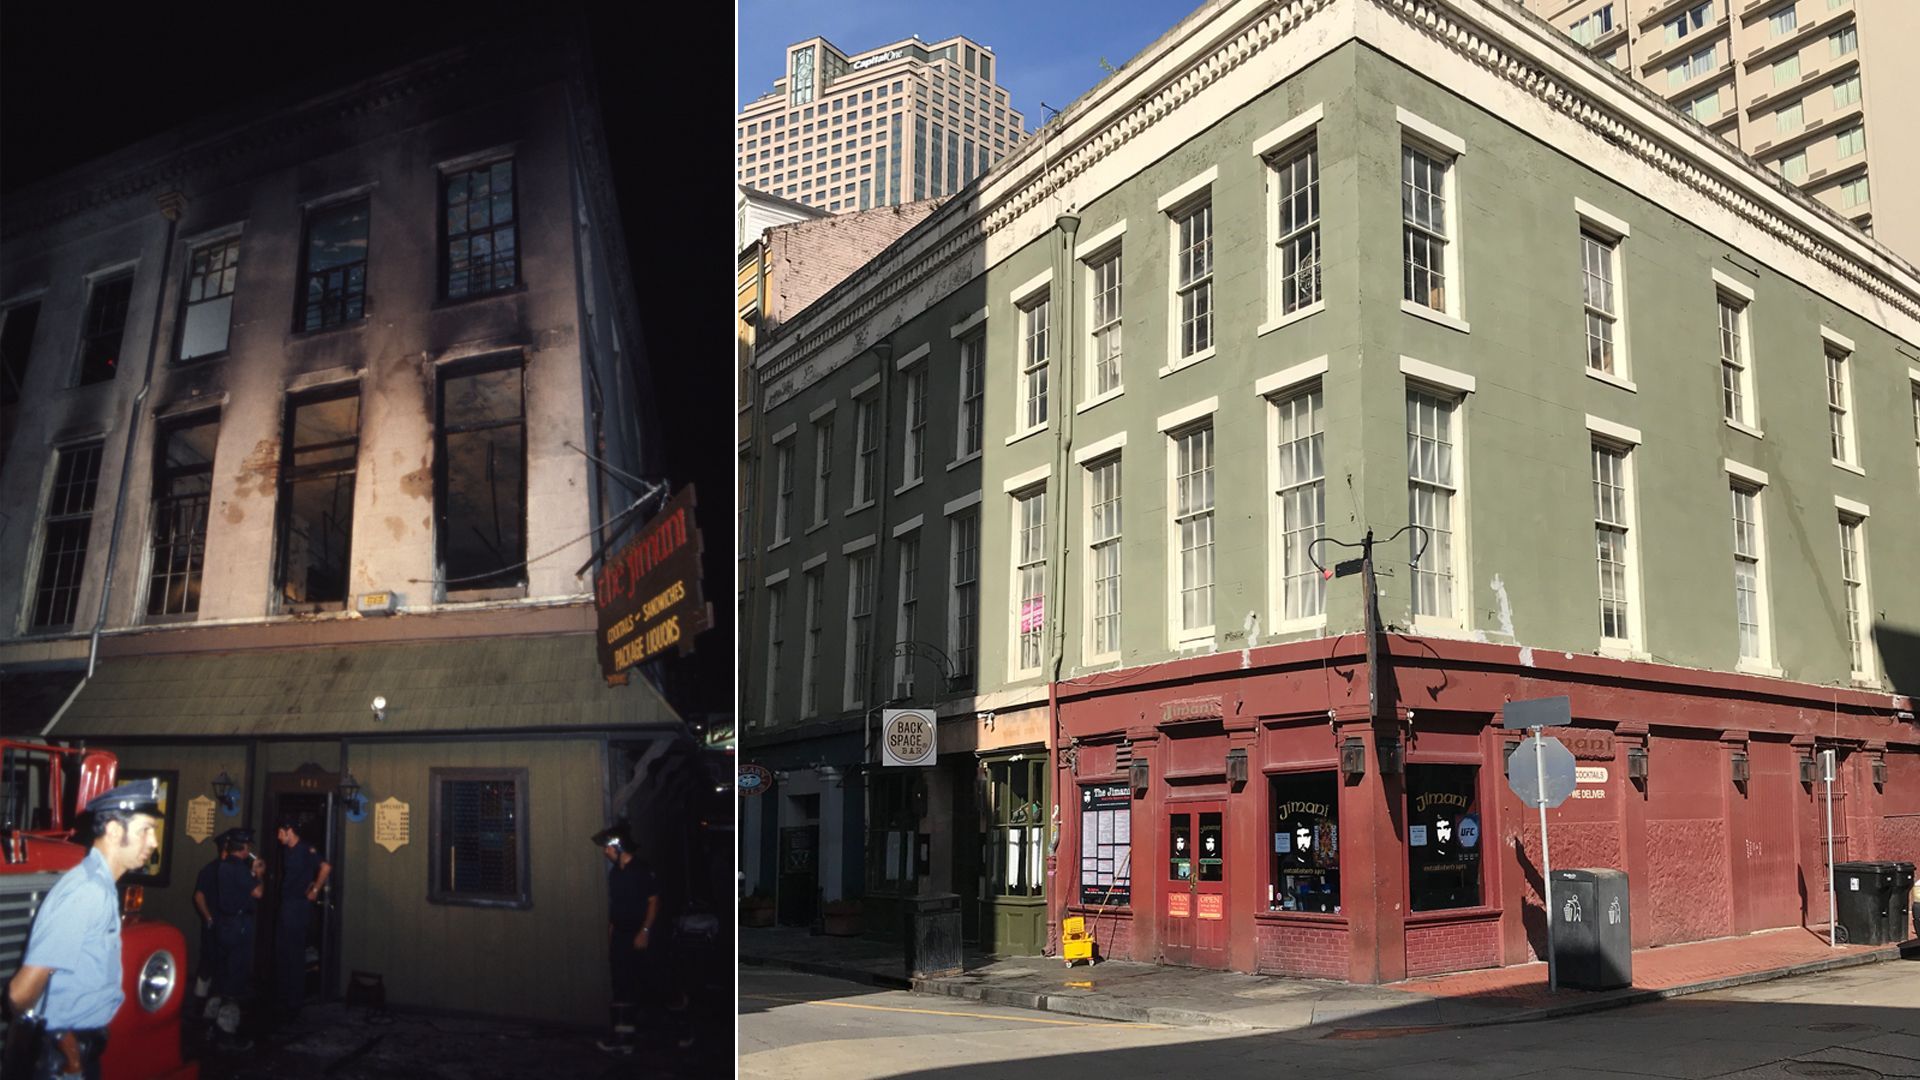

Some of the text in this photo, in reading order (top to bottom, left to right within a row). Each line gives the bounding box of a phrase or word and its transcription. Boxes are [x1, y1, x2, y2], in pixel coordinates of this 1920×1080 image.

[607, 614, 634, 645] COCKTAILS
[642, 580, 685, 622] SANDWICHES
[615, 615, 680, 672] PACKAGE LIQUORS
[1163, 702, 1213, 721] Jimani
[897, 721, 924, 734] BACK
[890, 734, 922, 747] SPACE
[902, 747, 922, 755] BAR
[1093, 787, 1131, 797] The Jimani
[1581, 789, 1606, 799] DELIVER
[1416, 791, 1468, 812] Jimani
[1279, 800, 1330, 821] Jimani
[1460, 827, 1475, 837] UFC
[1170, 894, 1188, 903] OPEN
[1200, 895, 1220, 904] OPEN
